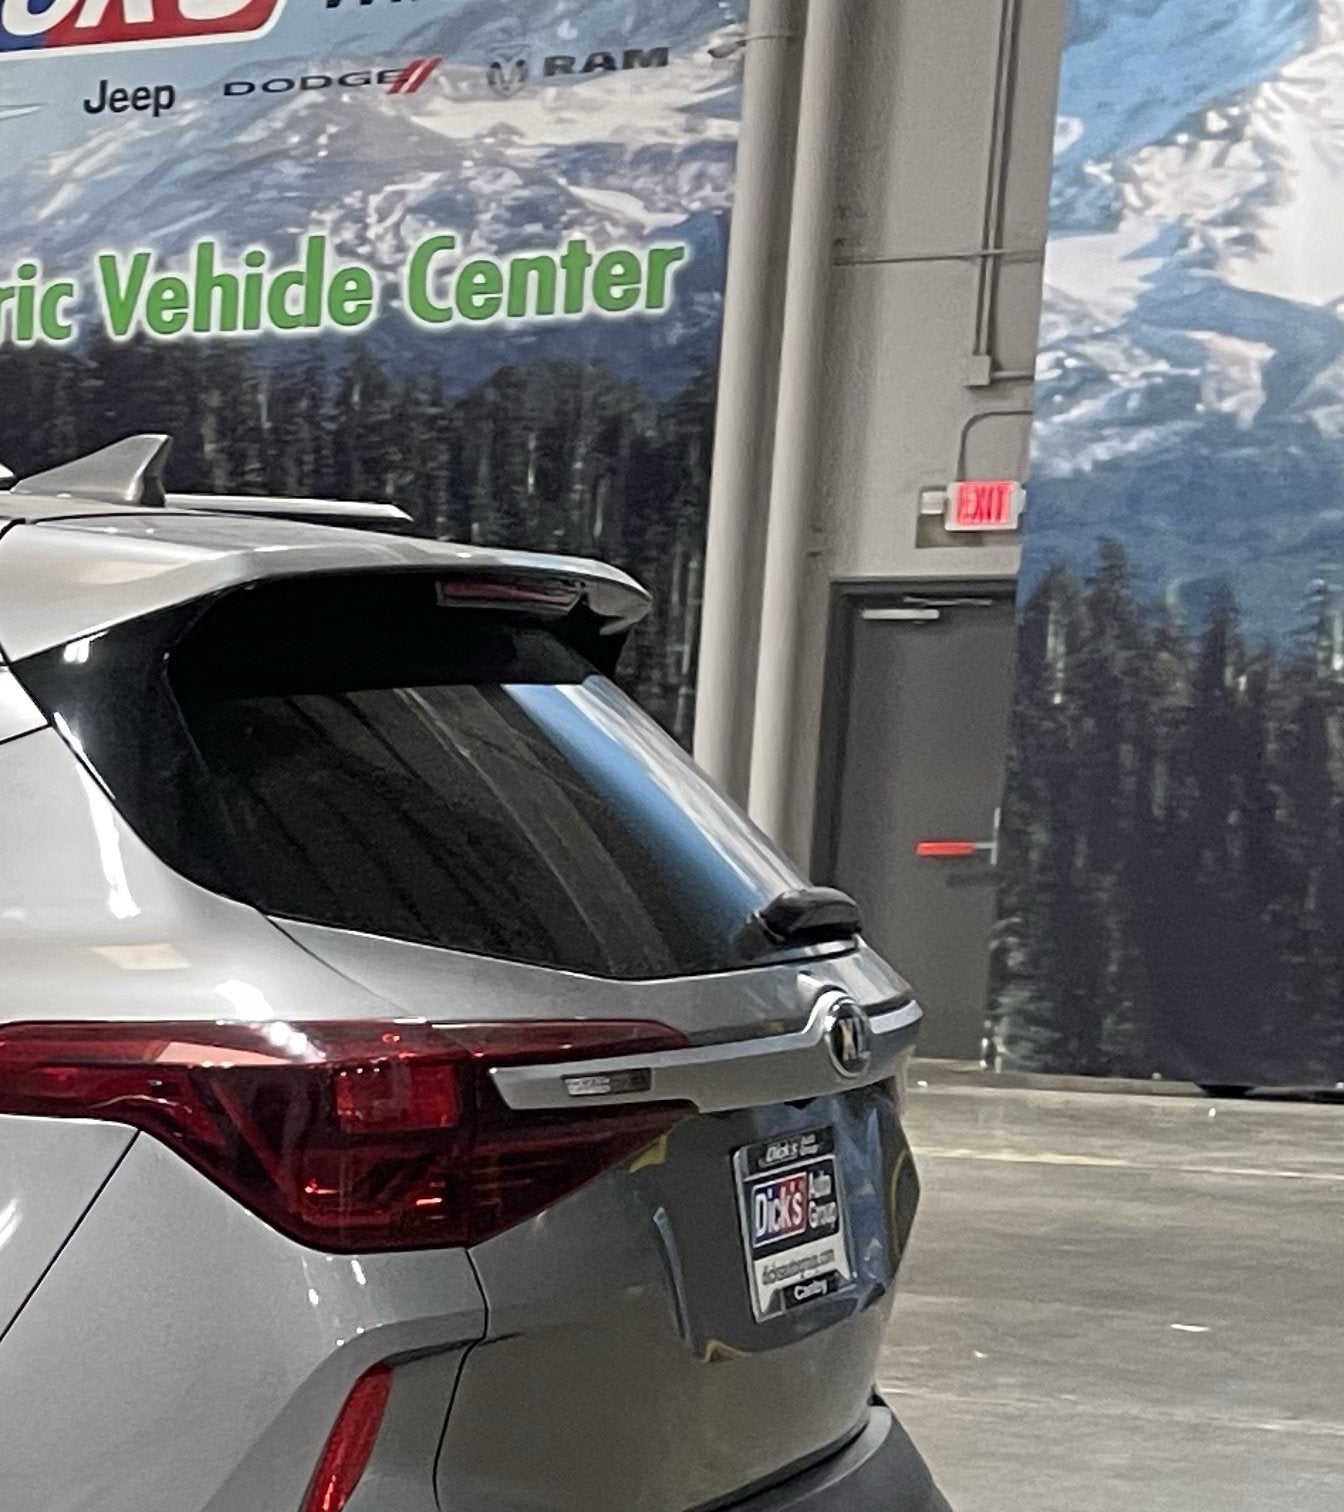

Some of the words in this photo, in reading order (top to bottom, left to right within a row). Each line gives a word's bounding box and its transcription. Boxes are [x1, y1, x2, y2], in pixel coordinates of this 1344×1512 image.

[542, 47, 670, 78] RAM
[83, 79, 176, 118] Jeep
[223, 68, 410, 97] DODGE
[97, 234, 374, 338] Vehicle
[407, 234, 686, 323] Center
[958, 484, 1014, 524] EXIT
[754, 1182, 803, 1238] Dick's
